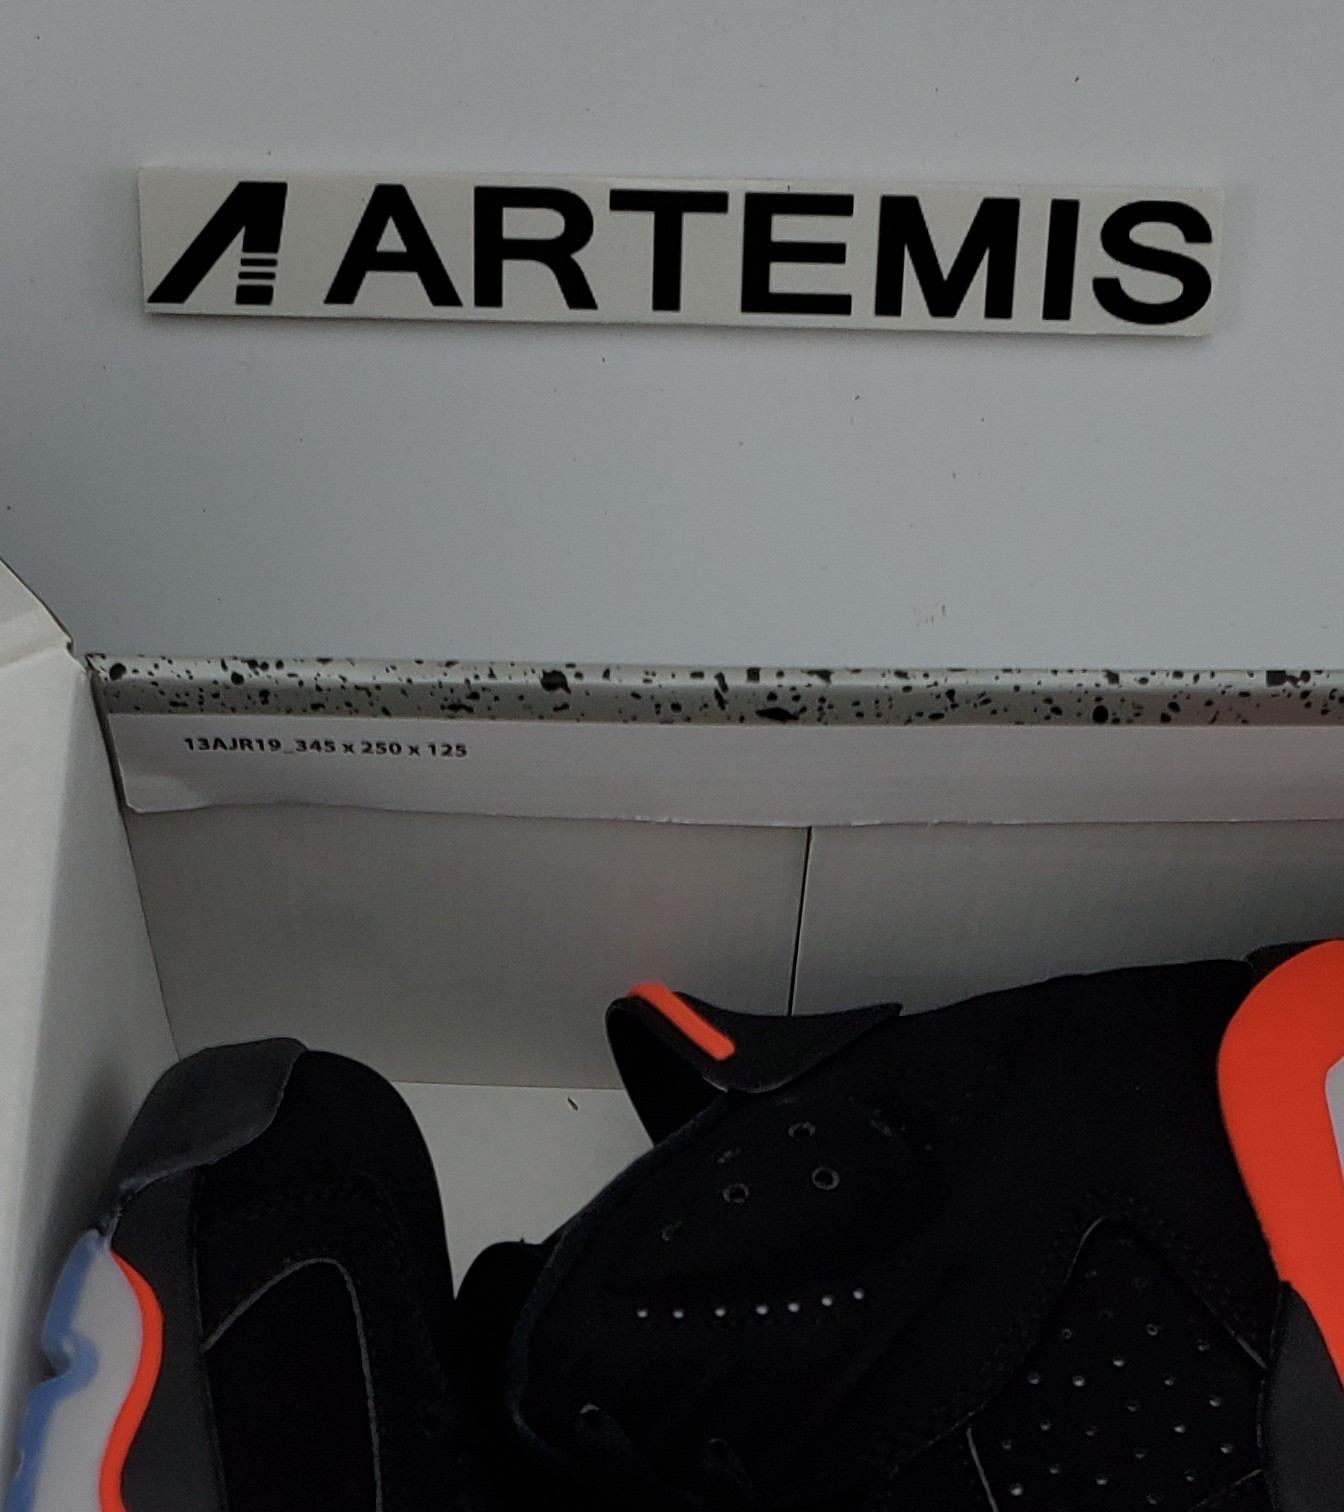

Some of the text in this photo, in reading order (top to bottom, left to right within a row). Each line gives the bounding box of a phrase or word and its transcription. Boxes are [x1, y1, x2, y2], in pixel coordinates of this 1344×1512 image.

[323, 183, 1213, 326] ARTEMIS
[360, 740, 403, 756] 250
[427, 742, 468, 758] 125
